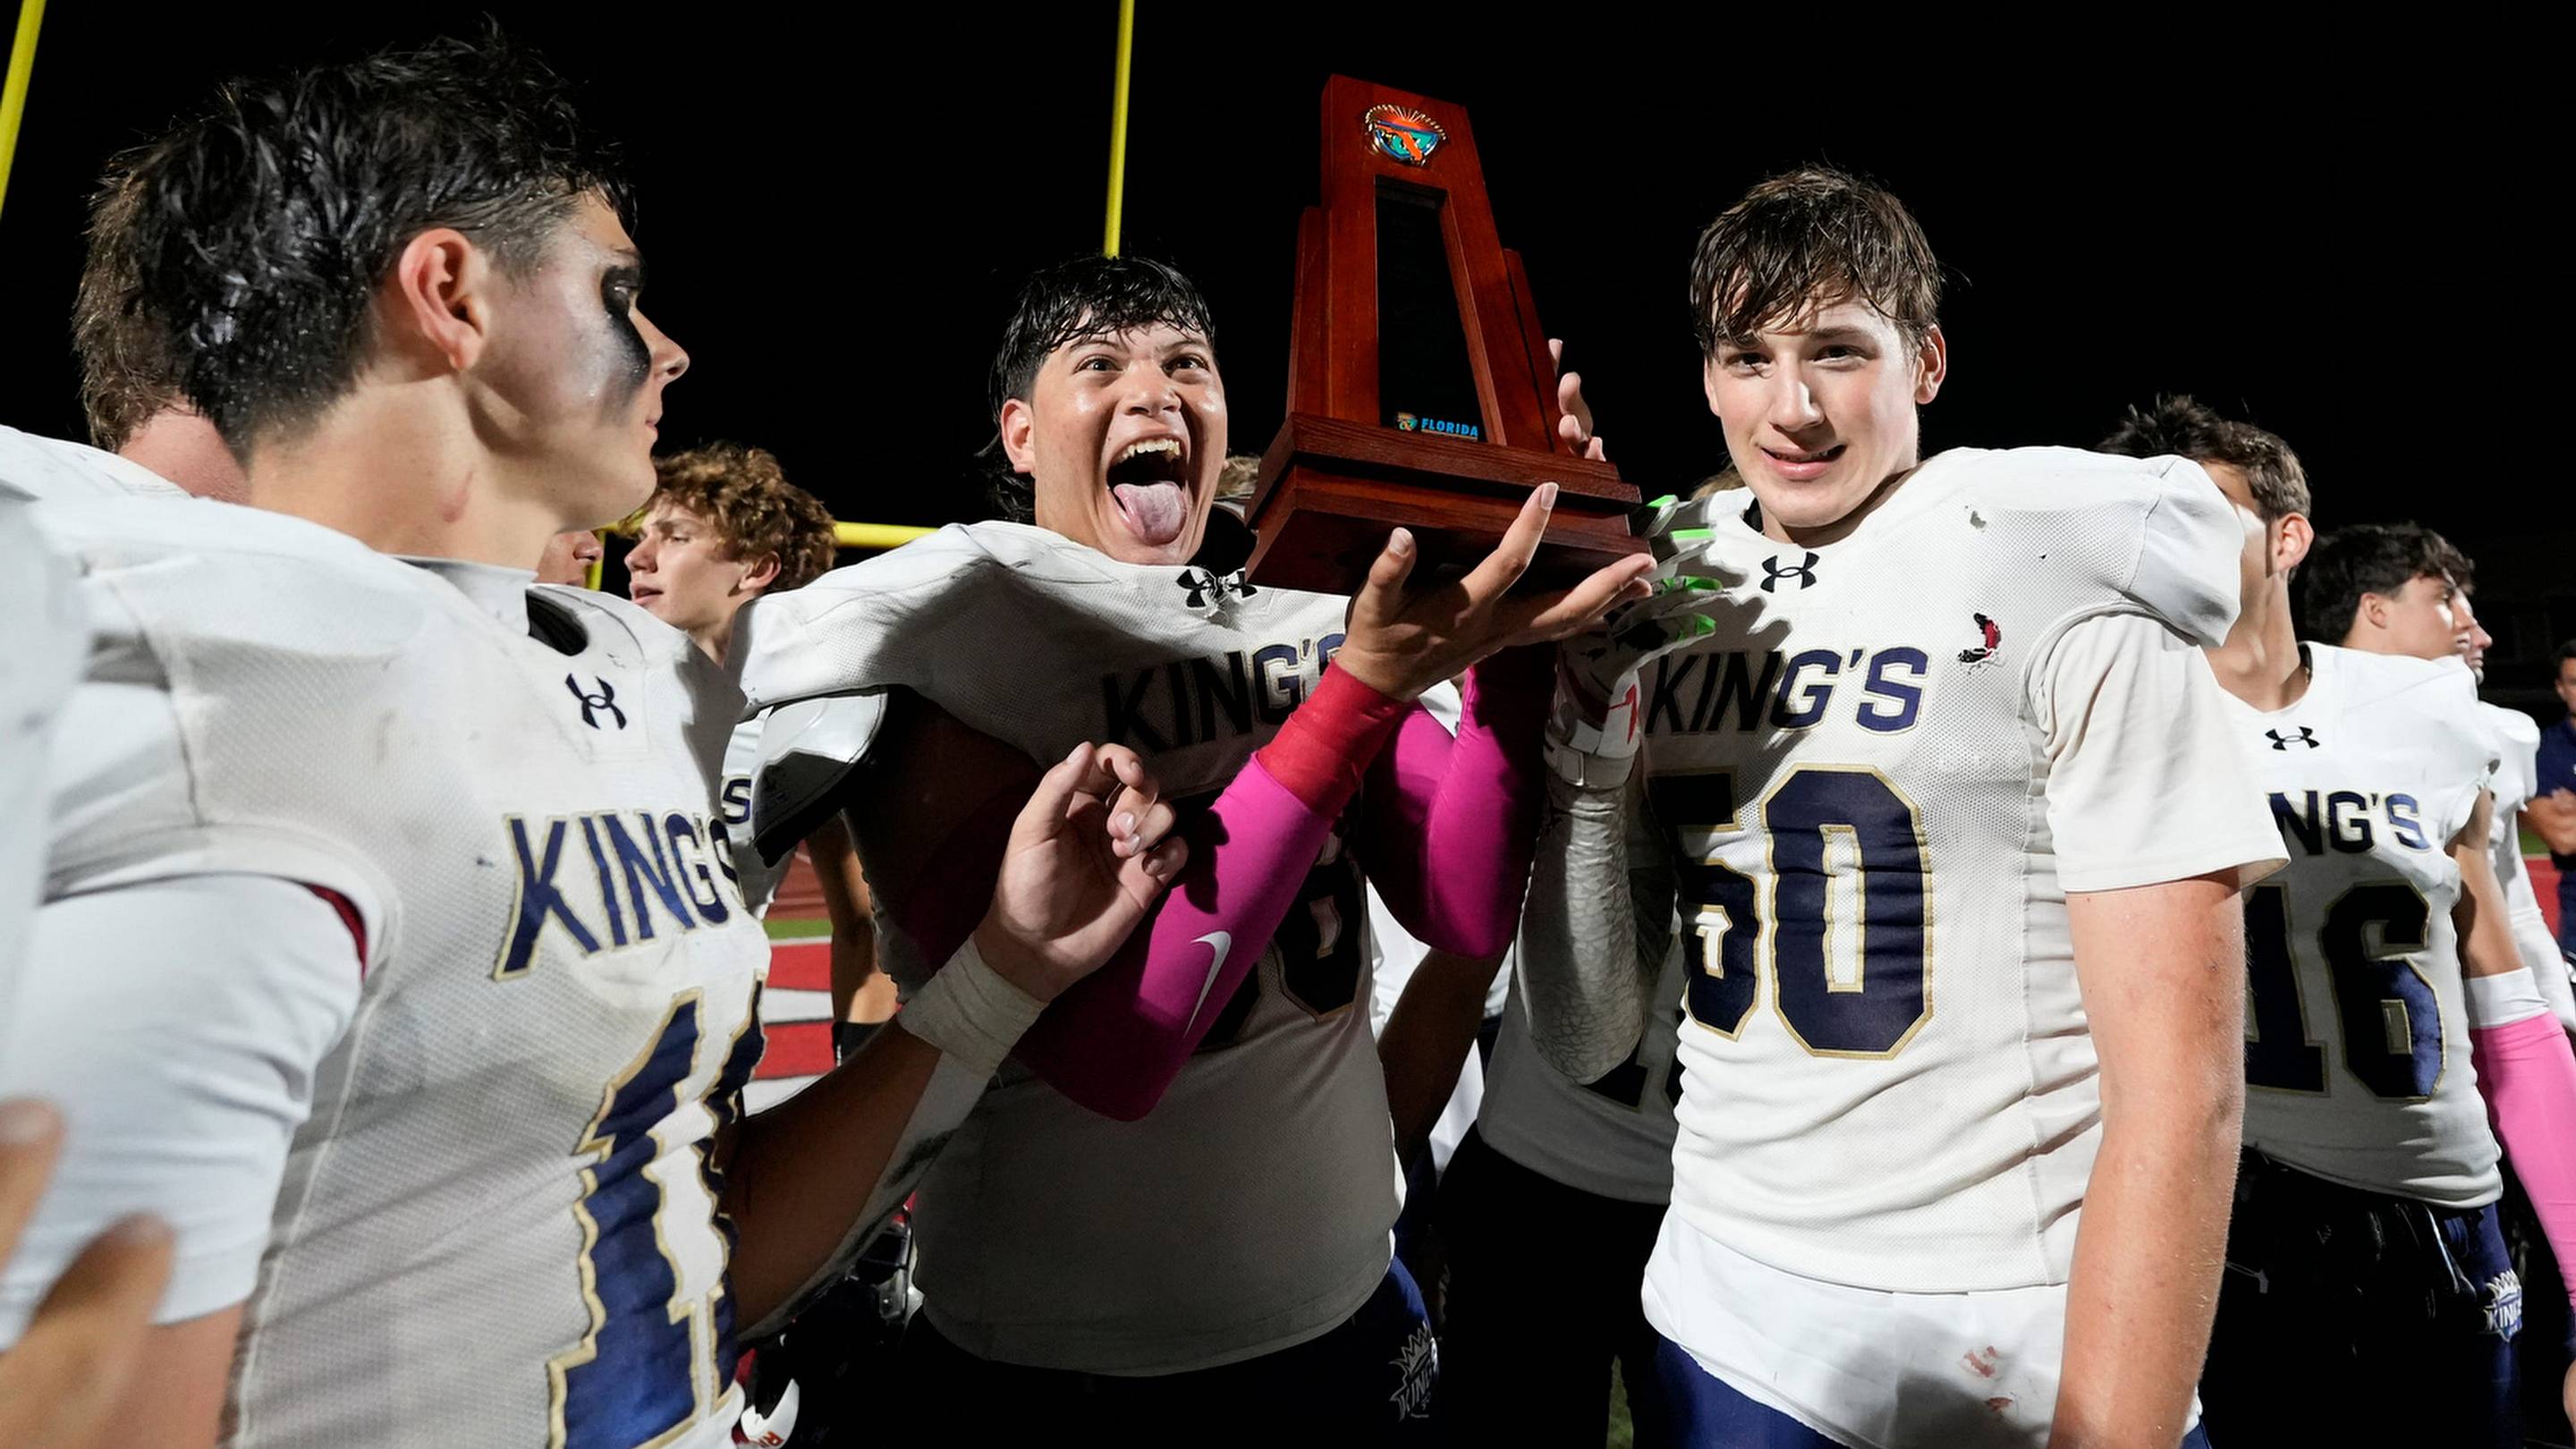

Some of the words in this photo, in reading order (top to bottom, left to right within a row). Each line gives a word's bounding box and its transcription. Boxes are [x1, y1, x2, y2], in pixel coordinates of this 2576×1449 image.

[1420, 417, 1479, 437] FLORIDA
[1643, 645, 1929, 734] KING'S
[2267, 790, 2432, 855] NG'S
[1646, 762, 1934, 1061] 50
[2244, 880, 2446, 1103] 16
